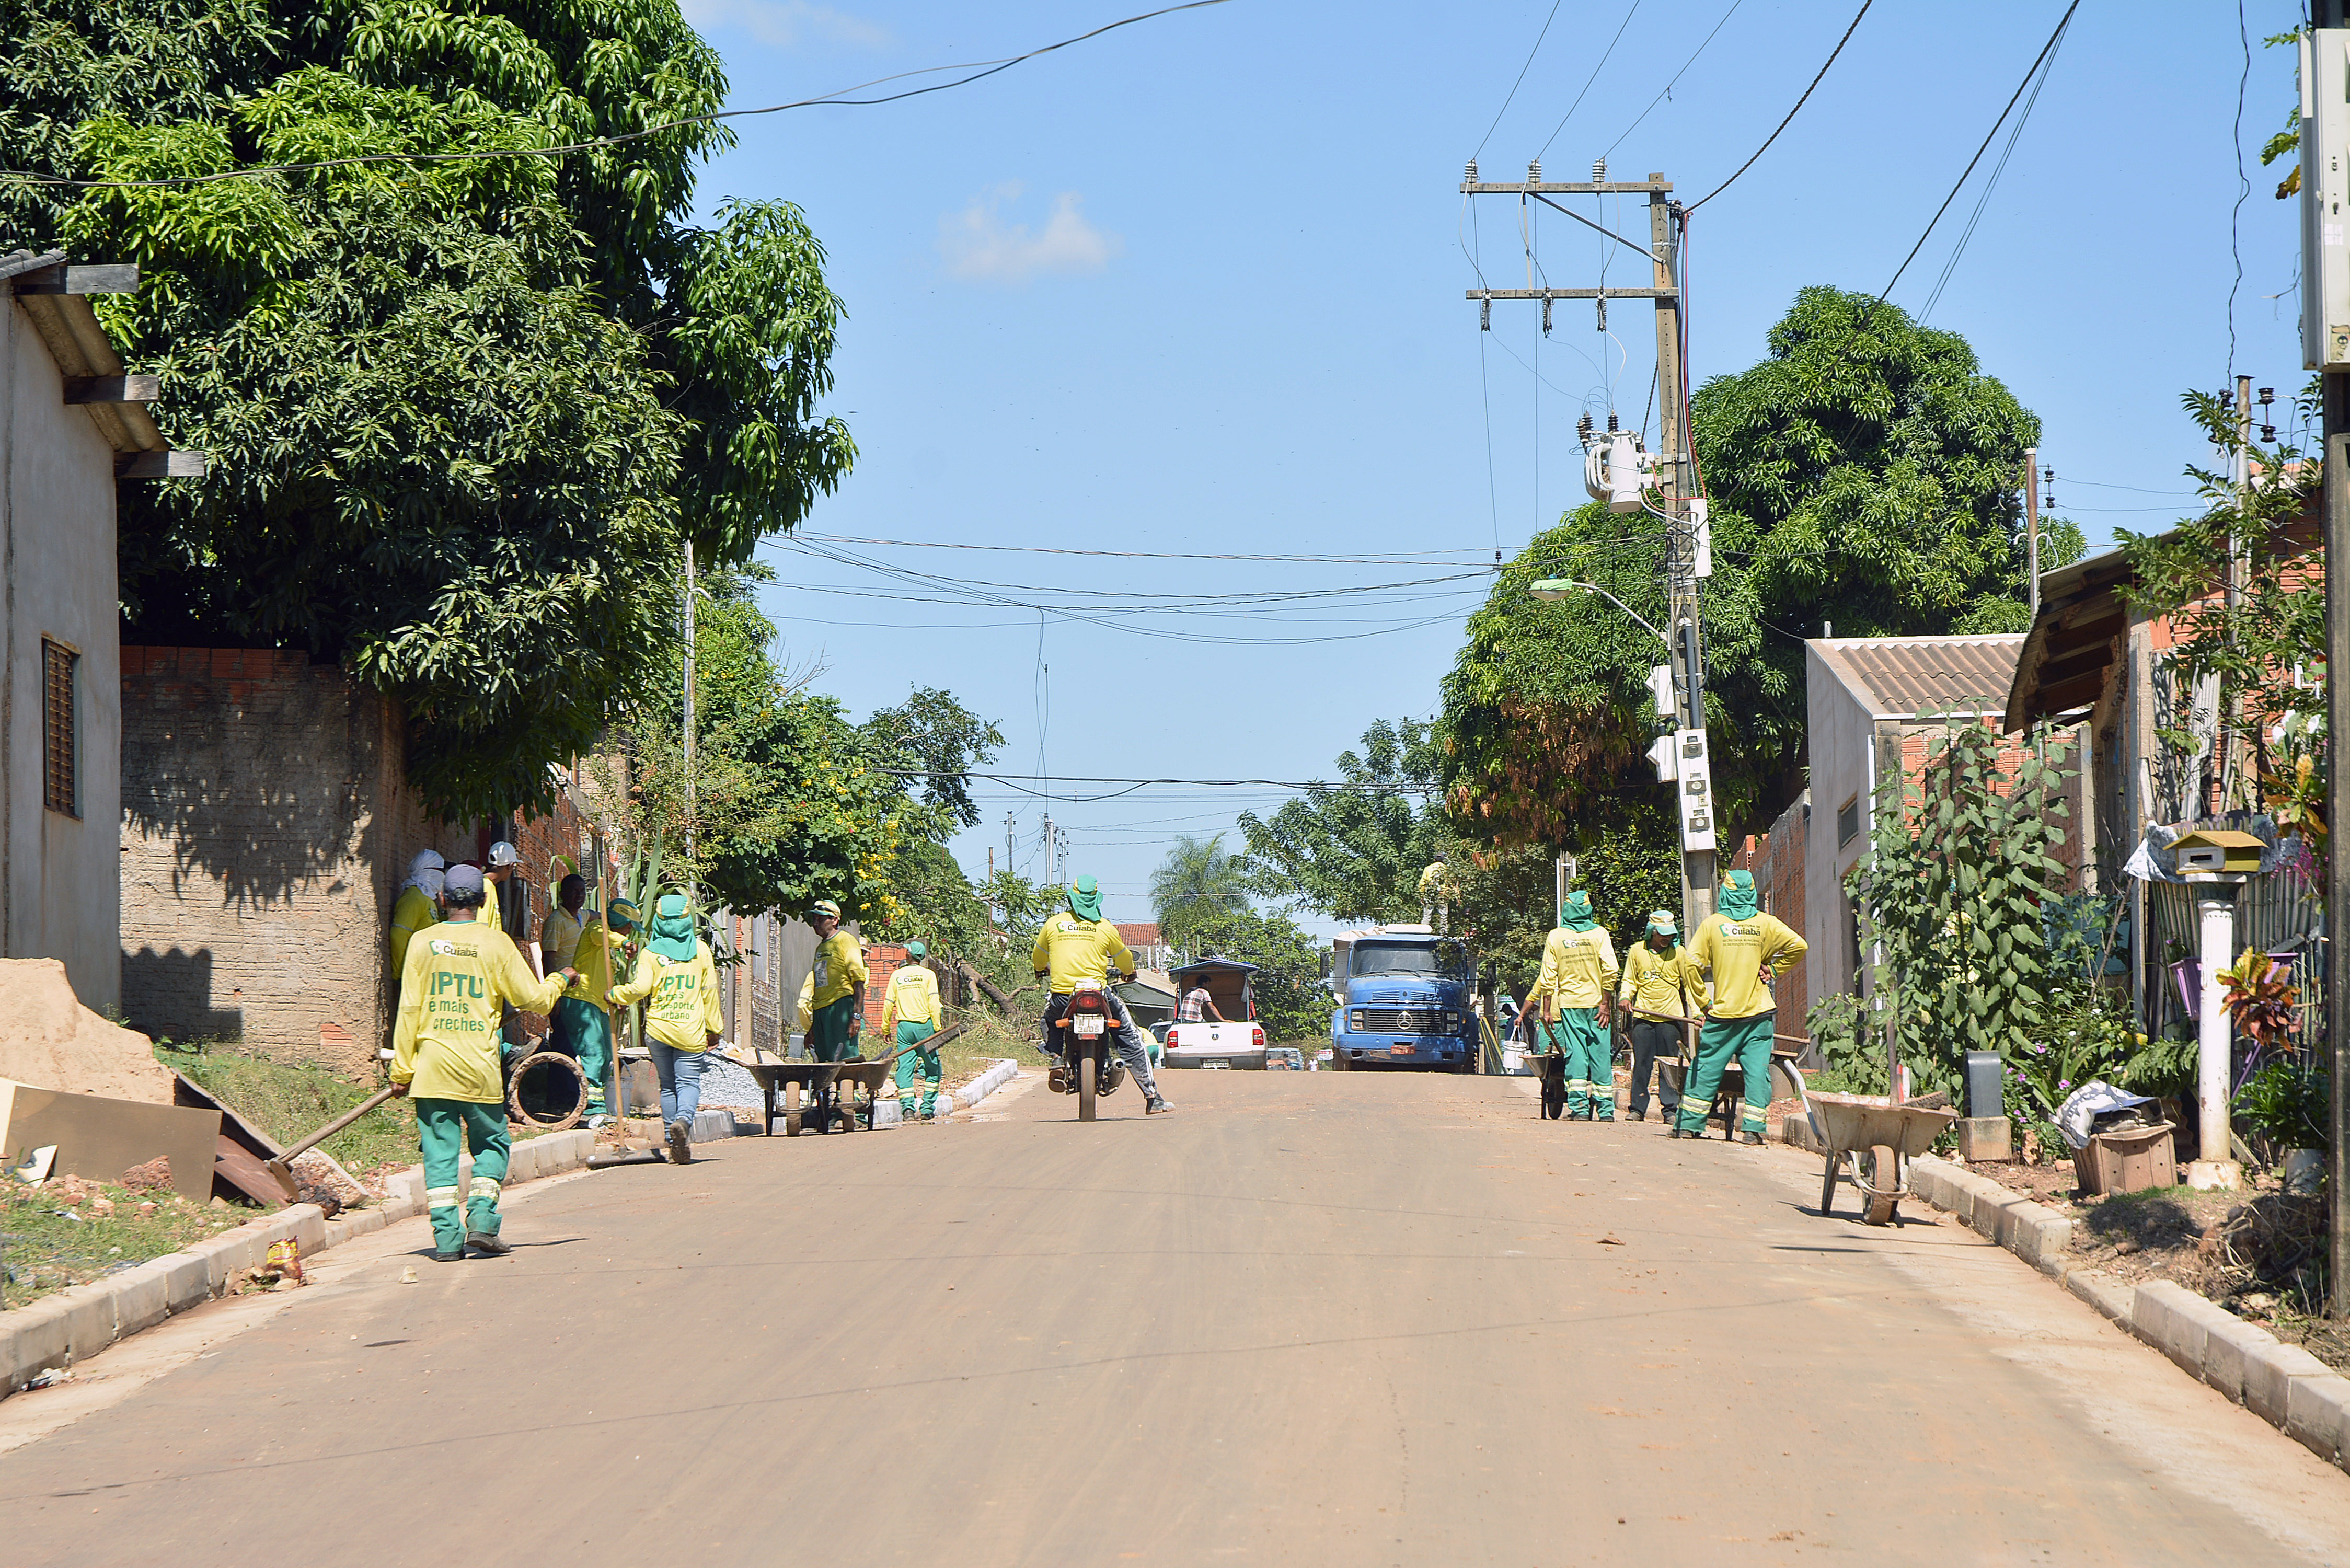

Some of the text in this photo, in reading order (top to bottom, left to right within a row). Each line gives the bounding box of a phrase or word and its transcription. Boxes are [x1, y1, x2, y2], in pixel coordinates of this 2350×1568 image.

[1067, 925, 1097, 933] Cuiabá
[1732, 928, 1761, 936] Cuiabá
[443, 945, 478, 958] Cuiabá
[430, 971, 484, 999] IPTU
[659, 974, 695, 991] IPTU
[429, 997, 469, 1014] é mais
[661, 1011, 690, 1019] urbano
[433, 1017, 485, 1032] creches
